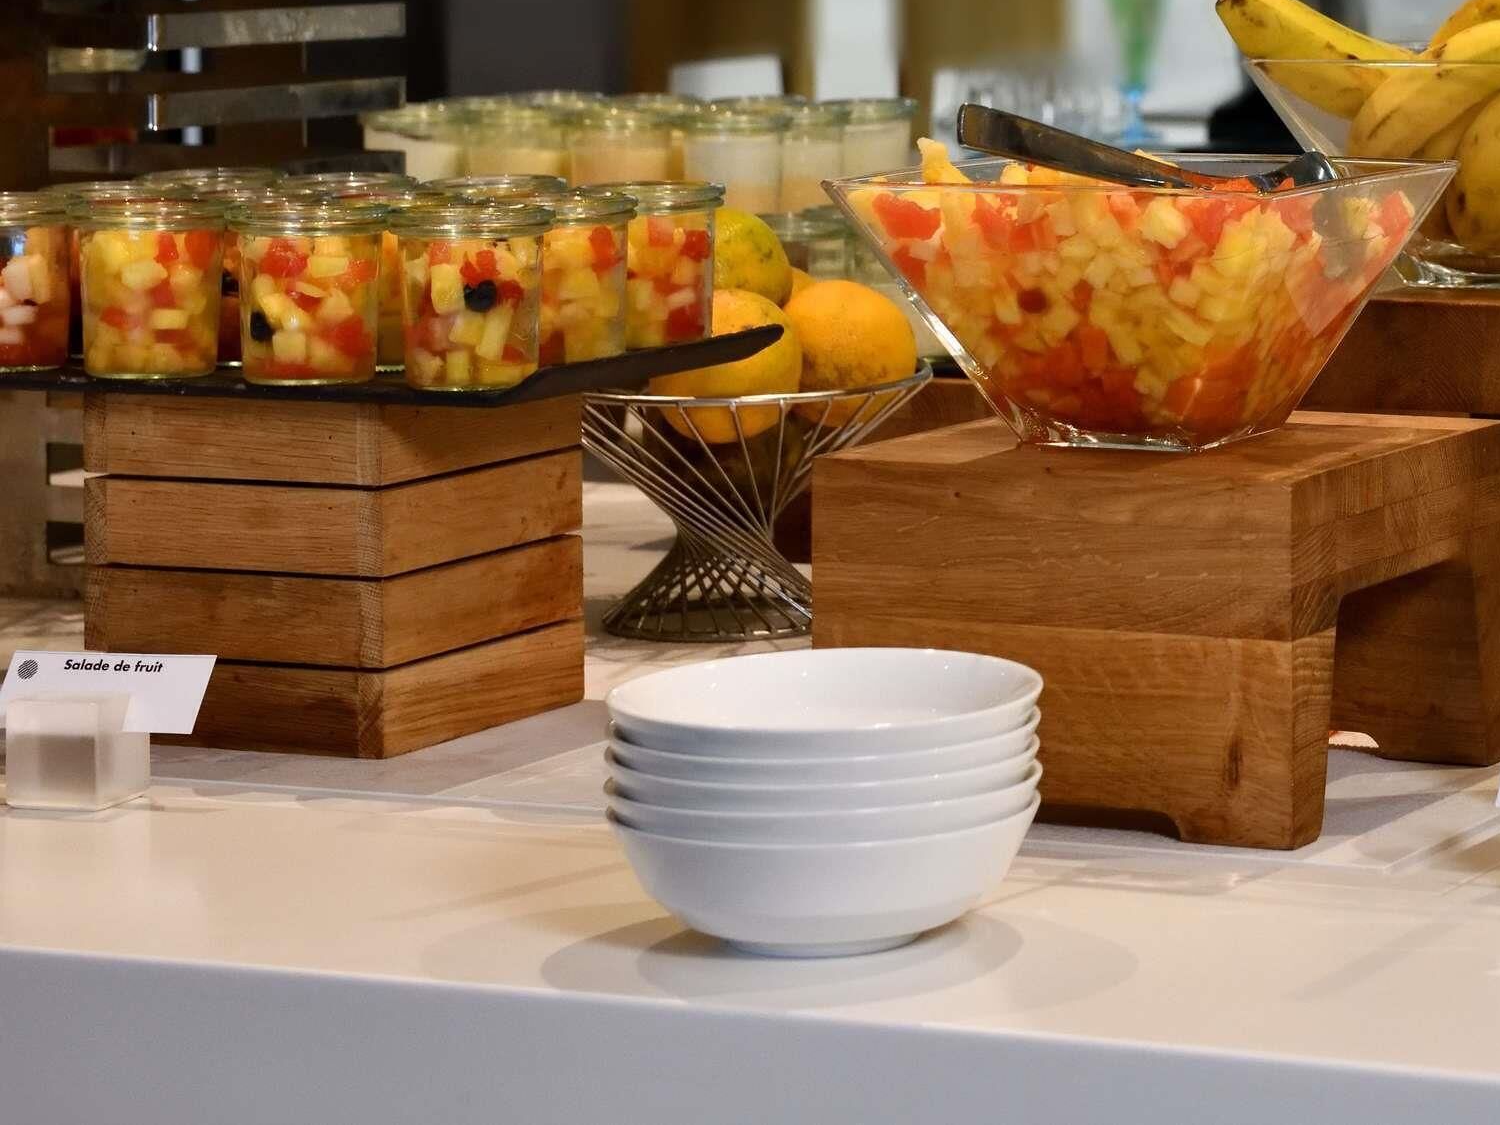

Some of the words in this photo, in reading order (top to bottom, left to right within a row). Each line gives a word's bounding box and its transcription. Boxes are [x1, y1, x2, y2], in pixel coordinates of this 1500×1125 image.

[64, 659, 110, 671] Salade
[113, 659, 131, 672] de
[134, 660, 163, 673] fruit
